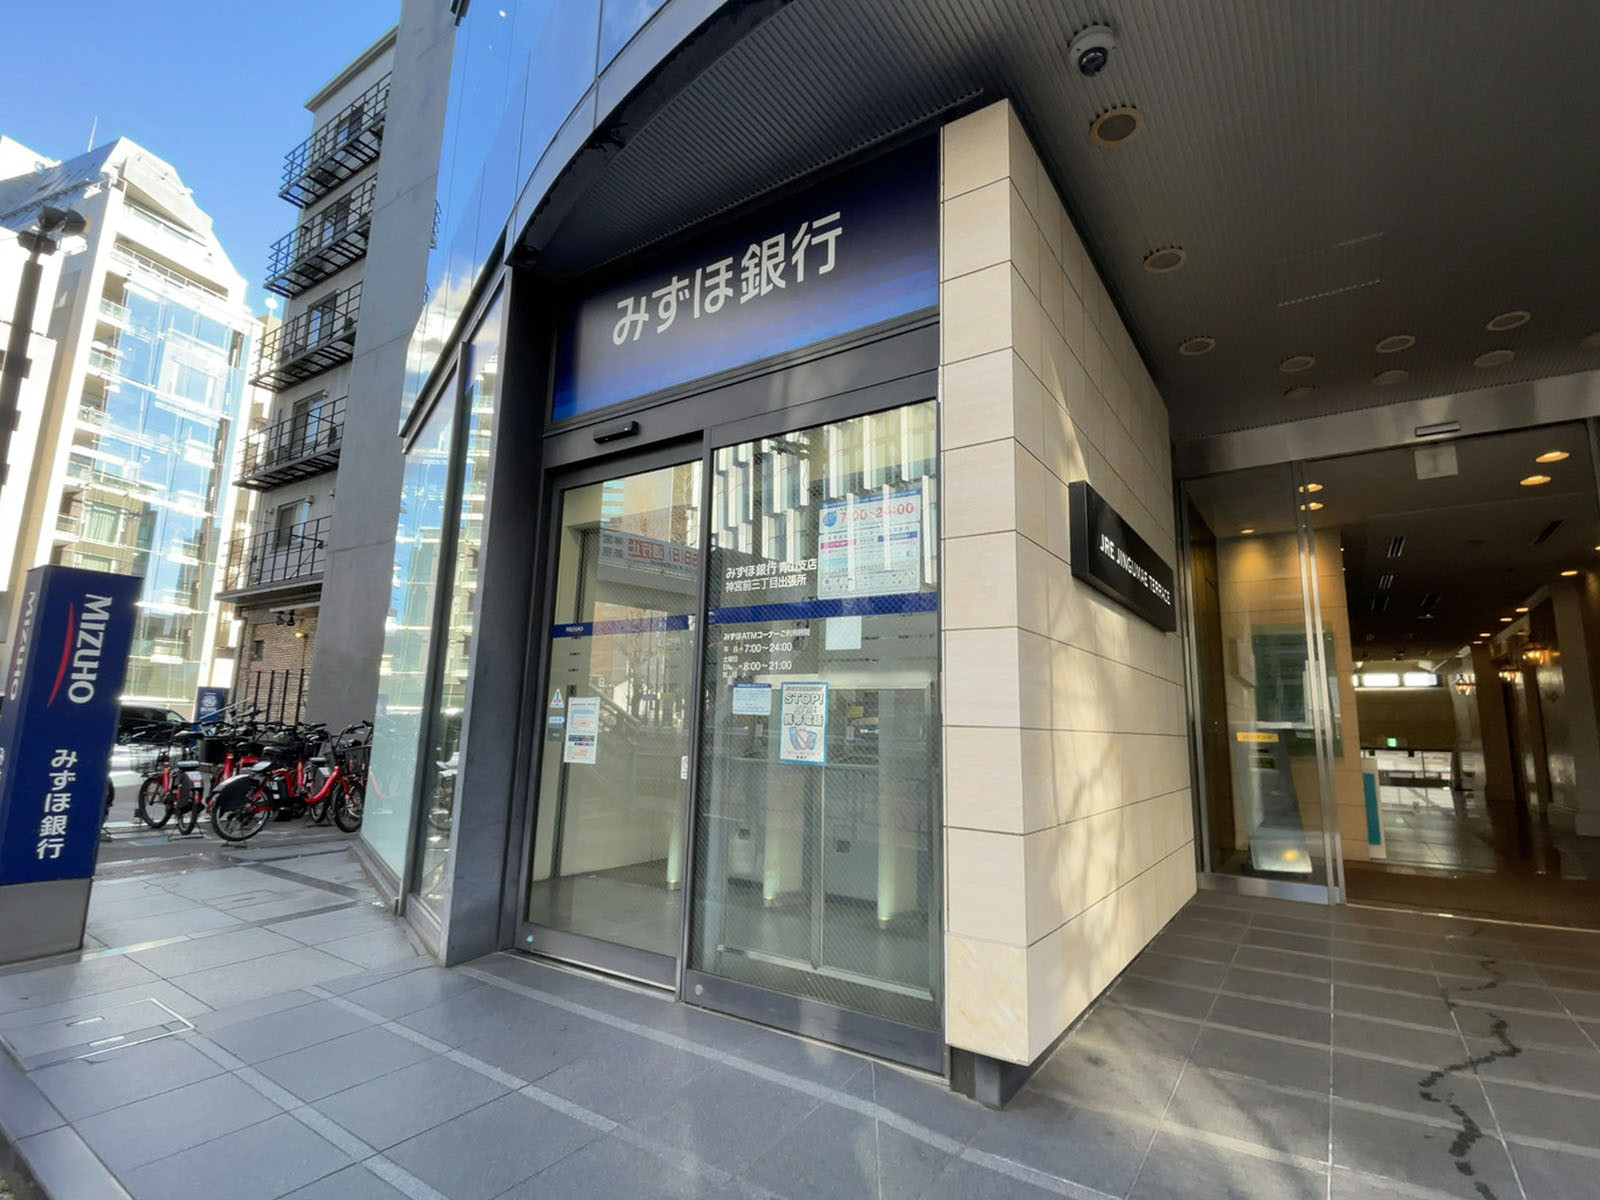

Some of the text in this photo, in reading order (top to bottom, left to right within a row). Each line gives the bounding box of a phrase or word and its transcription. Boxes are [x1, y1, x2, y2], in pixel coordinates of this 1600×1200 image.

[612, 211, 843, 346] みずほ銀行
[725, 560, 777, 579] みずほ銀行
[1100, 533, 1115, 560] JRE
[67, 593, 113, 704] MIZUHO
[784, 693, 824, 705] STOP!
[36, 748, 78, 860] みずほ銀行
